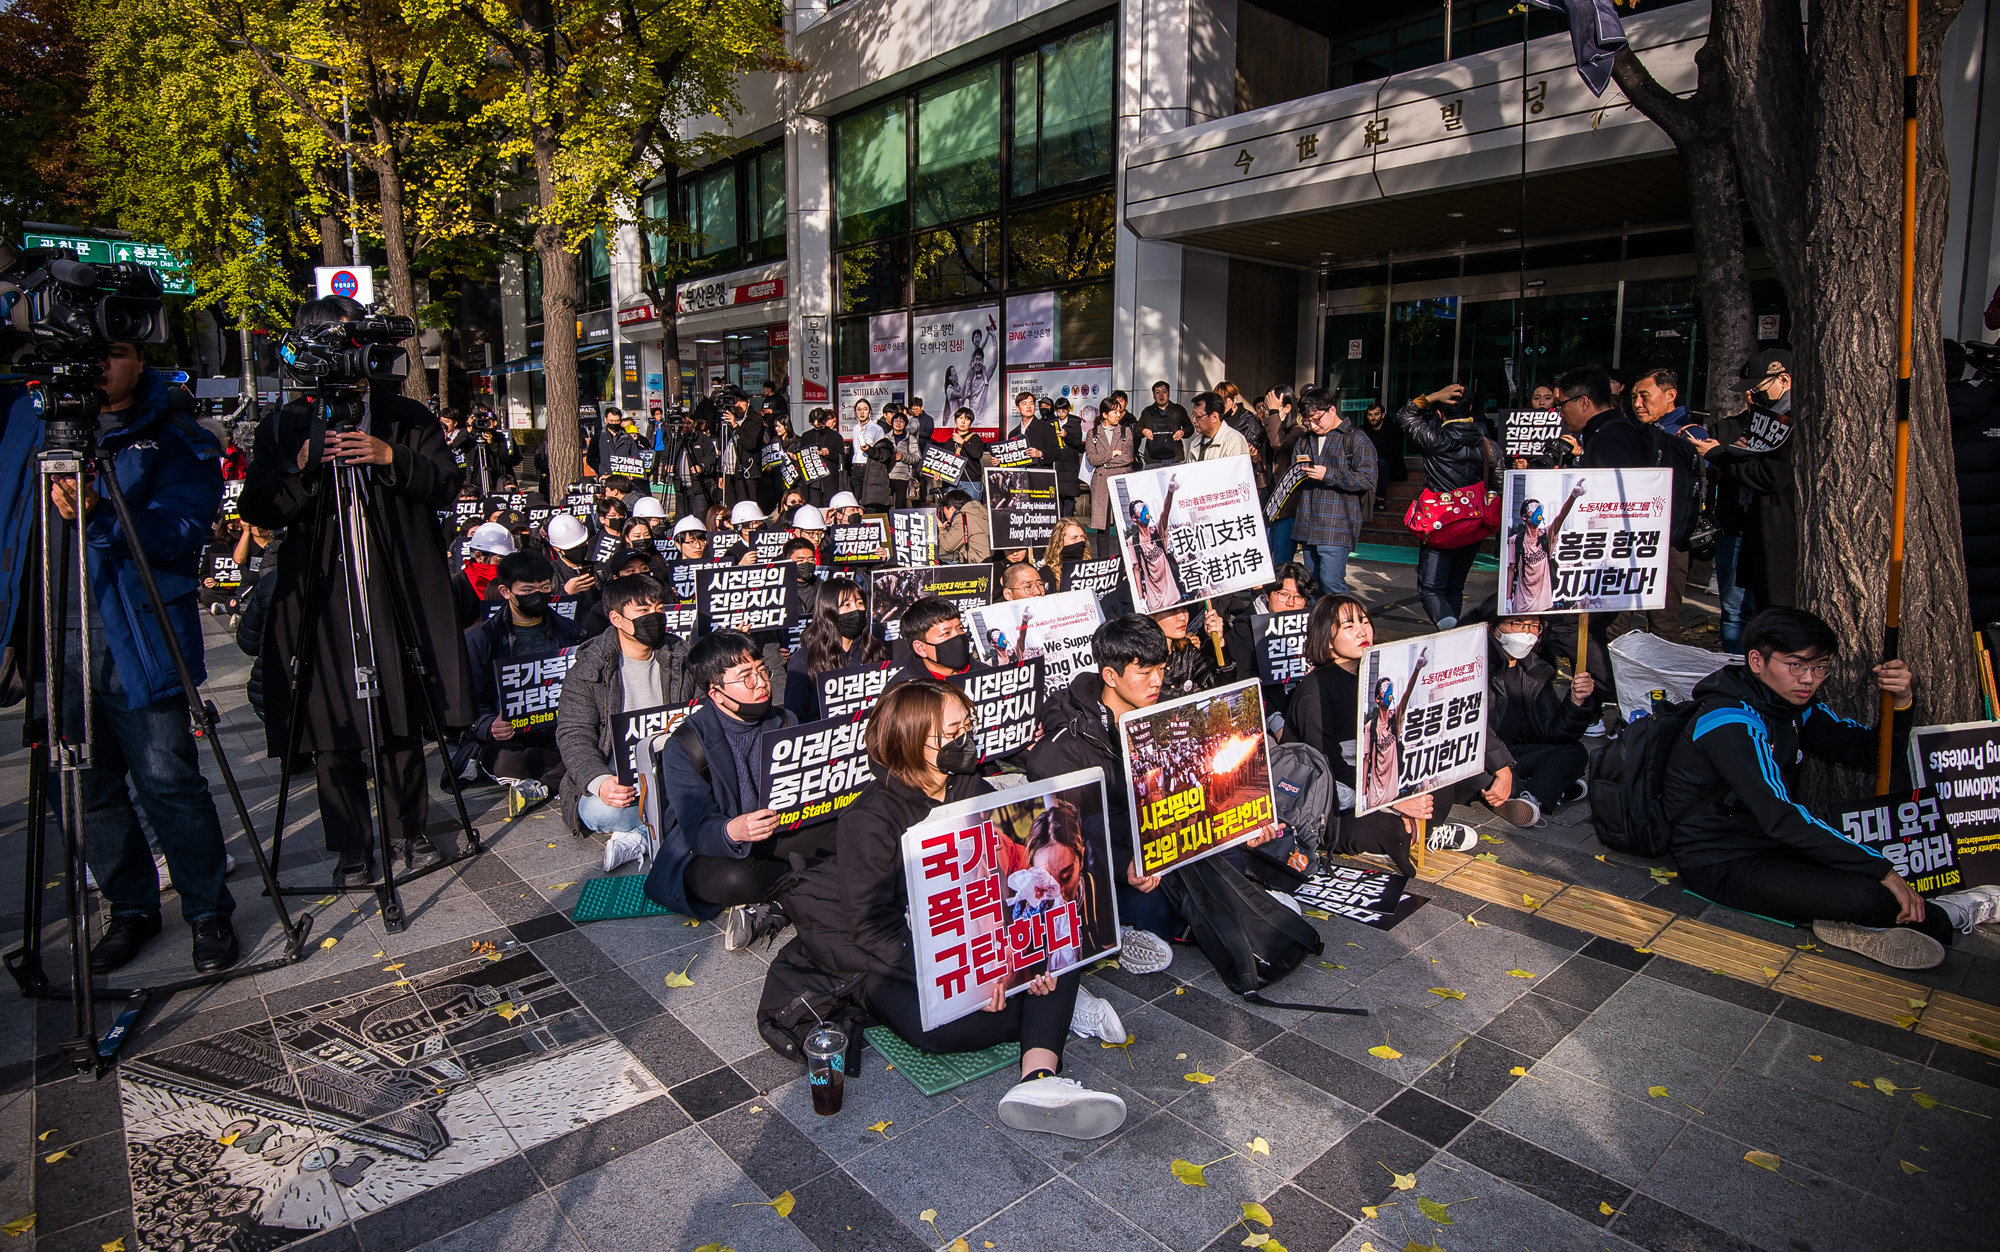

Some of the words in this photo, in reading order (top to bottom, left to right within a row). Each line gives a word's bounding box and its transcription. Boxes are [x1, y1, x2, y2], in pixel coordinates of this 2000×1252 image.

[686, 282, 728, 310] 부산은행
[775, 329, 789, 341] 365코
[920, 325, 939, 337] 고객을
[941, 324, 954, 337] 향한
[1008, 332, 1026, 341] BNK
[1027, 328, 1051, 339] 부산은행
[808, 322, 821, 380] 부산은행
[887, 342, 905, 352] 부산은행
[920, 343, 927, 355] 단
[928, 342, 948, 354] 하나의
[948, 340, 965, 352] 진심!
[650, 401, 661, 409] SIM
[1506, 411, 1561, 426] 시진핑의
[1750, 412, 1771, 438] 5대
[1765, 420, 1789, 445] 요구
[1506, 426, 1562, 441] 진압지시
[990, 439, 1028, 453] 국가폭력
[1506, 441, 1546, 456] 규탄한
[610, 455, 643, 467] 국가폭력
[800, 448, 819, 480] 중단하라
[922, 457, 961, 478] 규탄한다
[926, 448, 966, 469] 국가폭력
[610, 464, 644, 475] 규탄한다
[456, 503, 476, 514] 5대
[568, 495, 594, 505] 국가폭
[1578, 502, 1619, 513] 노동자연대
[530, 510, 548, 520] 5대
[1010, 513, 1023, 527] Stop
[1024, 512, 1051, 524] Crackdown
[1051, 516, 1057, 524] on
[712, 534, 742, 548] 인권
[834, 526, 880, 541] 홍콩항쟁
[894, 514, 910, 567] 가폭력
[910, 512, 927, 567] 탄한다
[1009, 528, 1024, 541] Hong
[1172, 514, 1257, 556] 我们支持
[834, 540, 880, 555] 지지한다
[1558, 532, 1607, 561] 홍콩
[1612, 530, 1660, 559] 항쟁
[214, 558, 239, 570] 5대
[1070, 557, 1121, 578] 시진핑의
[1181, 548, 1264, 591] 香港抗争
[214, 570, 242, 582] 수용
[708, 567, 785, 591] 시진핑의
[1555, 567, 1658, 598] 지지한다!
[710, 588, 786, 612] 진압지시
[665, 610, 697, 629] 폭력
[710, 608, 787, 632] 규탄한다
[1057, 614, 1075, 623] Students
[1044, 642, 1062, 654] We
[1063, 634, 1093, 649] Suppo
[1268, 635, 1307, 659] 진압
[1044, 659, 1071, 676] ong
[1072, 652, 1097, 669] Ko
[1271, 657, 1314, 680] 규탄
[964, 664, 1035, 701] 시진핑의
[512, 716, 529, 729] Stop
[530, 713, 554, 725] State
[1404, 702, 1444, 743] 홍콩
[1446, 691, 1483, 731] 항쟁
[1401, 732, 1480, 784] 지지한다!
[1930, 746, 1985, 773] Protests
[801, 802, 832, 821] State
[1140, 785, 1206, 833] 시진핑의
[1842, 806, 1892, 845] 5대
[1898, 797, 1941, 838] 요구
[1144, 832, 1179, 872] 진압
[1180, 821, 1213, 855] 지시
[1213, 794, 1273, 840] 규탄한다
[921, 820, 999, 882] 국가
[1882, 832, 1954, 878] 용하라
[1958, 841, 1977, 855] Group
[1308, 873, 1386, 898] 진압지
[1917, 875, 1936, 893] NOT
[1935, 874, 1941, 889] 1
[1941, 870, 1961, 887] LESS
[928, 873, 1003, 937] 폭력
[1294, 884, 1382, 908] 시진핑
[934, 900, 1082, 1000] 규탄한다
